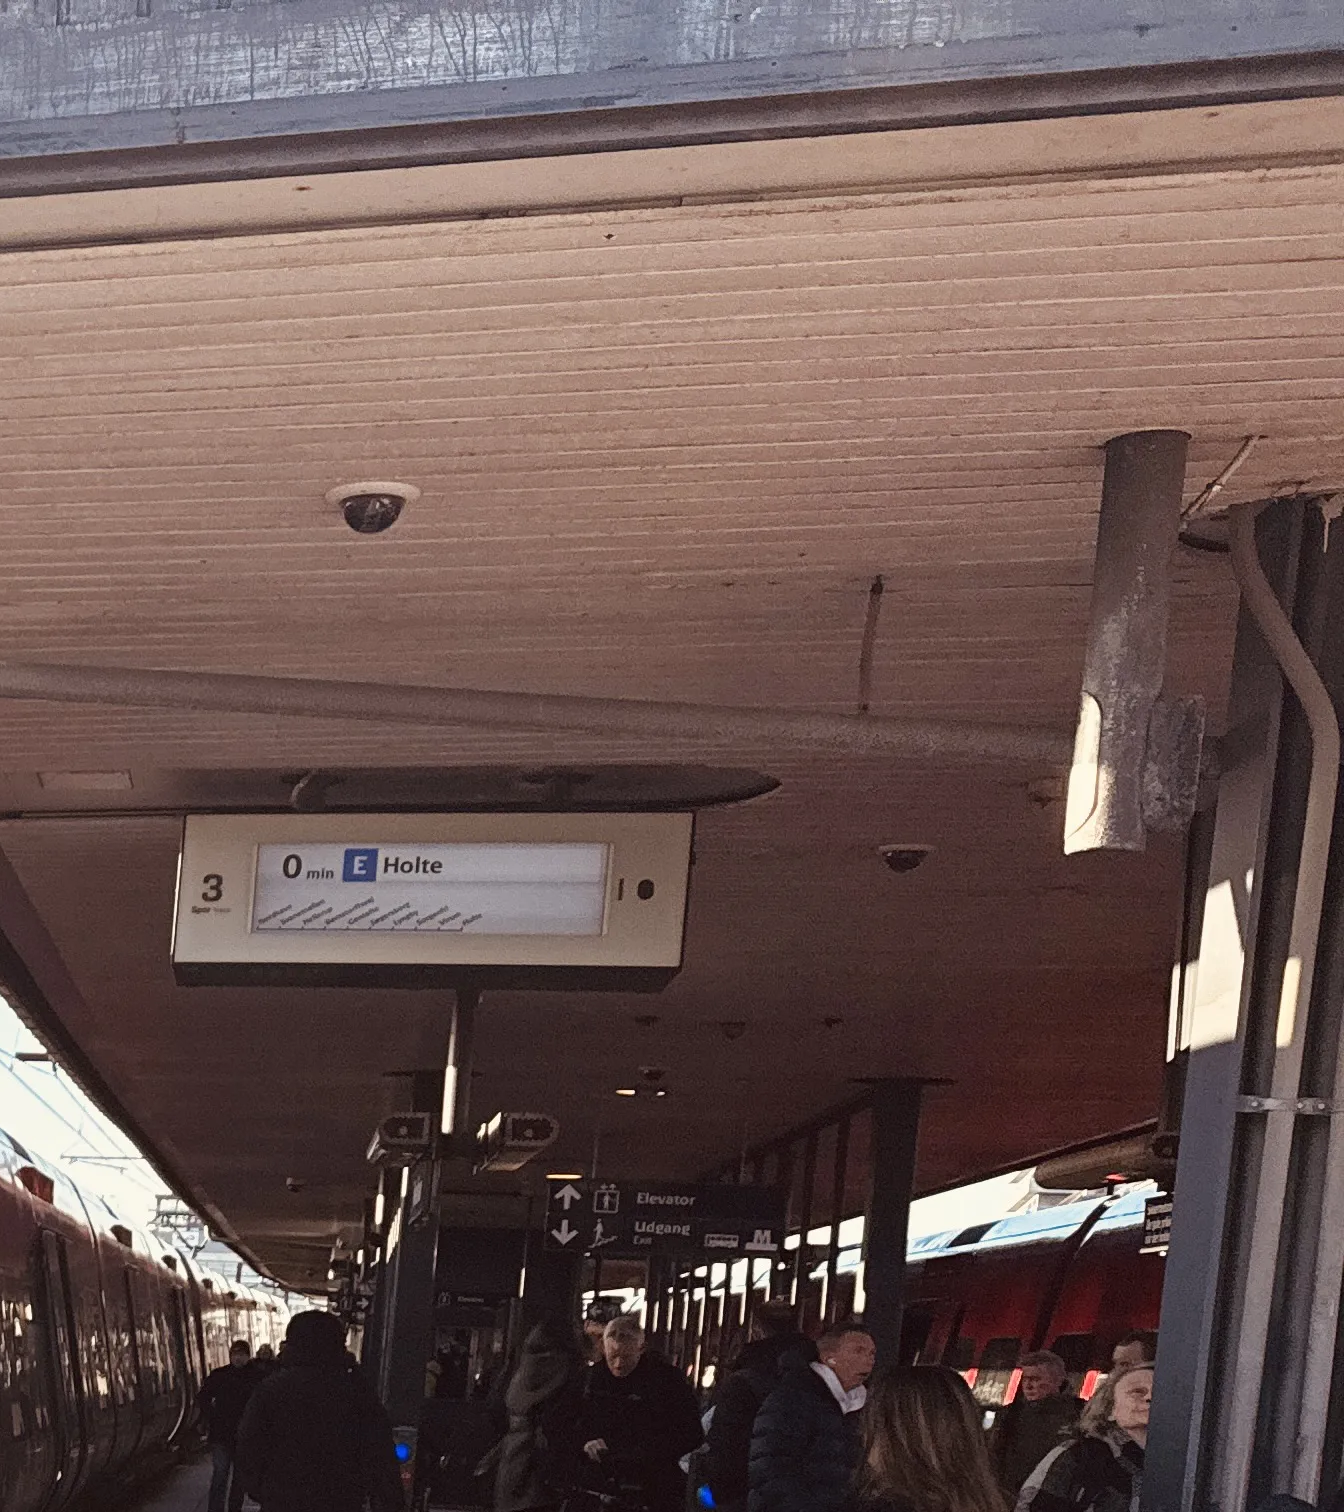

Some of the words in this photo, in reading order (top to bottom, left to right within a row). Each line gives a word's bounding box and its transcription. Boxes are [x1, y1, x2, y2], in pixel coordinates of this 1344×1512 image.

[282, 853, 303, 879] 0
[306, 867, 335, 880] min
[352, 855, 368, 875] E
[383, 855, 444, 875] Holte
[201, 873, 223, 902] 3
[636, 1191, 697, 1206] Elevator
[634, 1220, 691, 1237] Udgang
